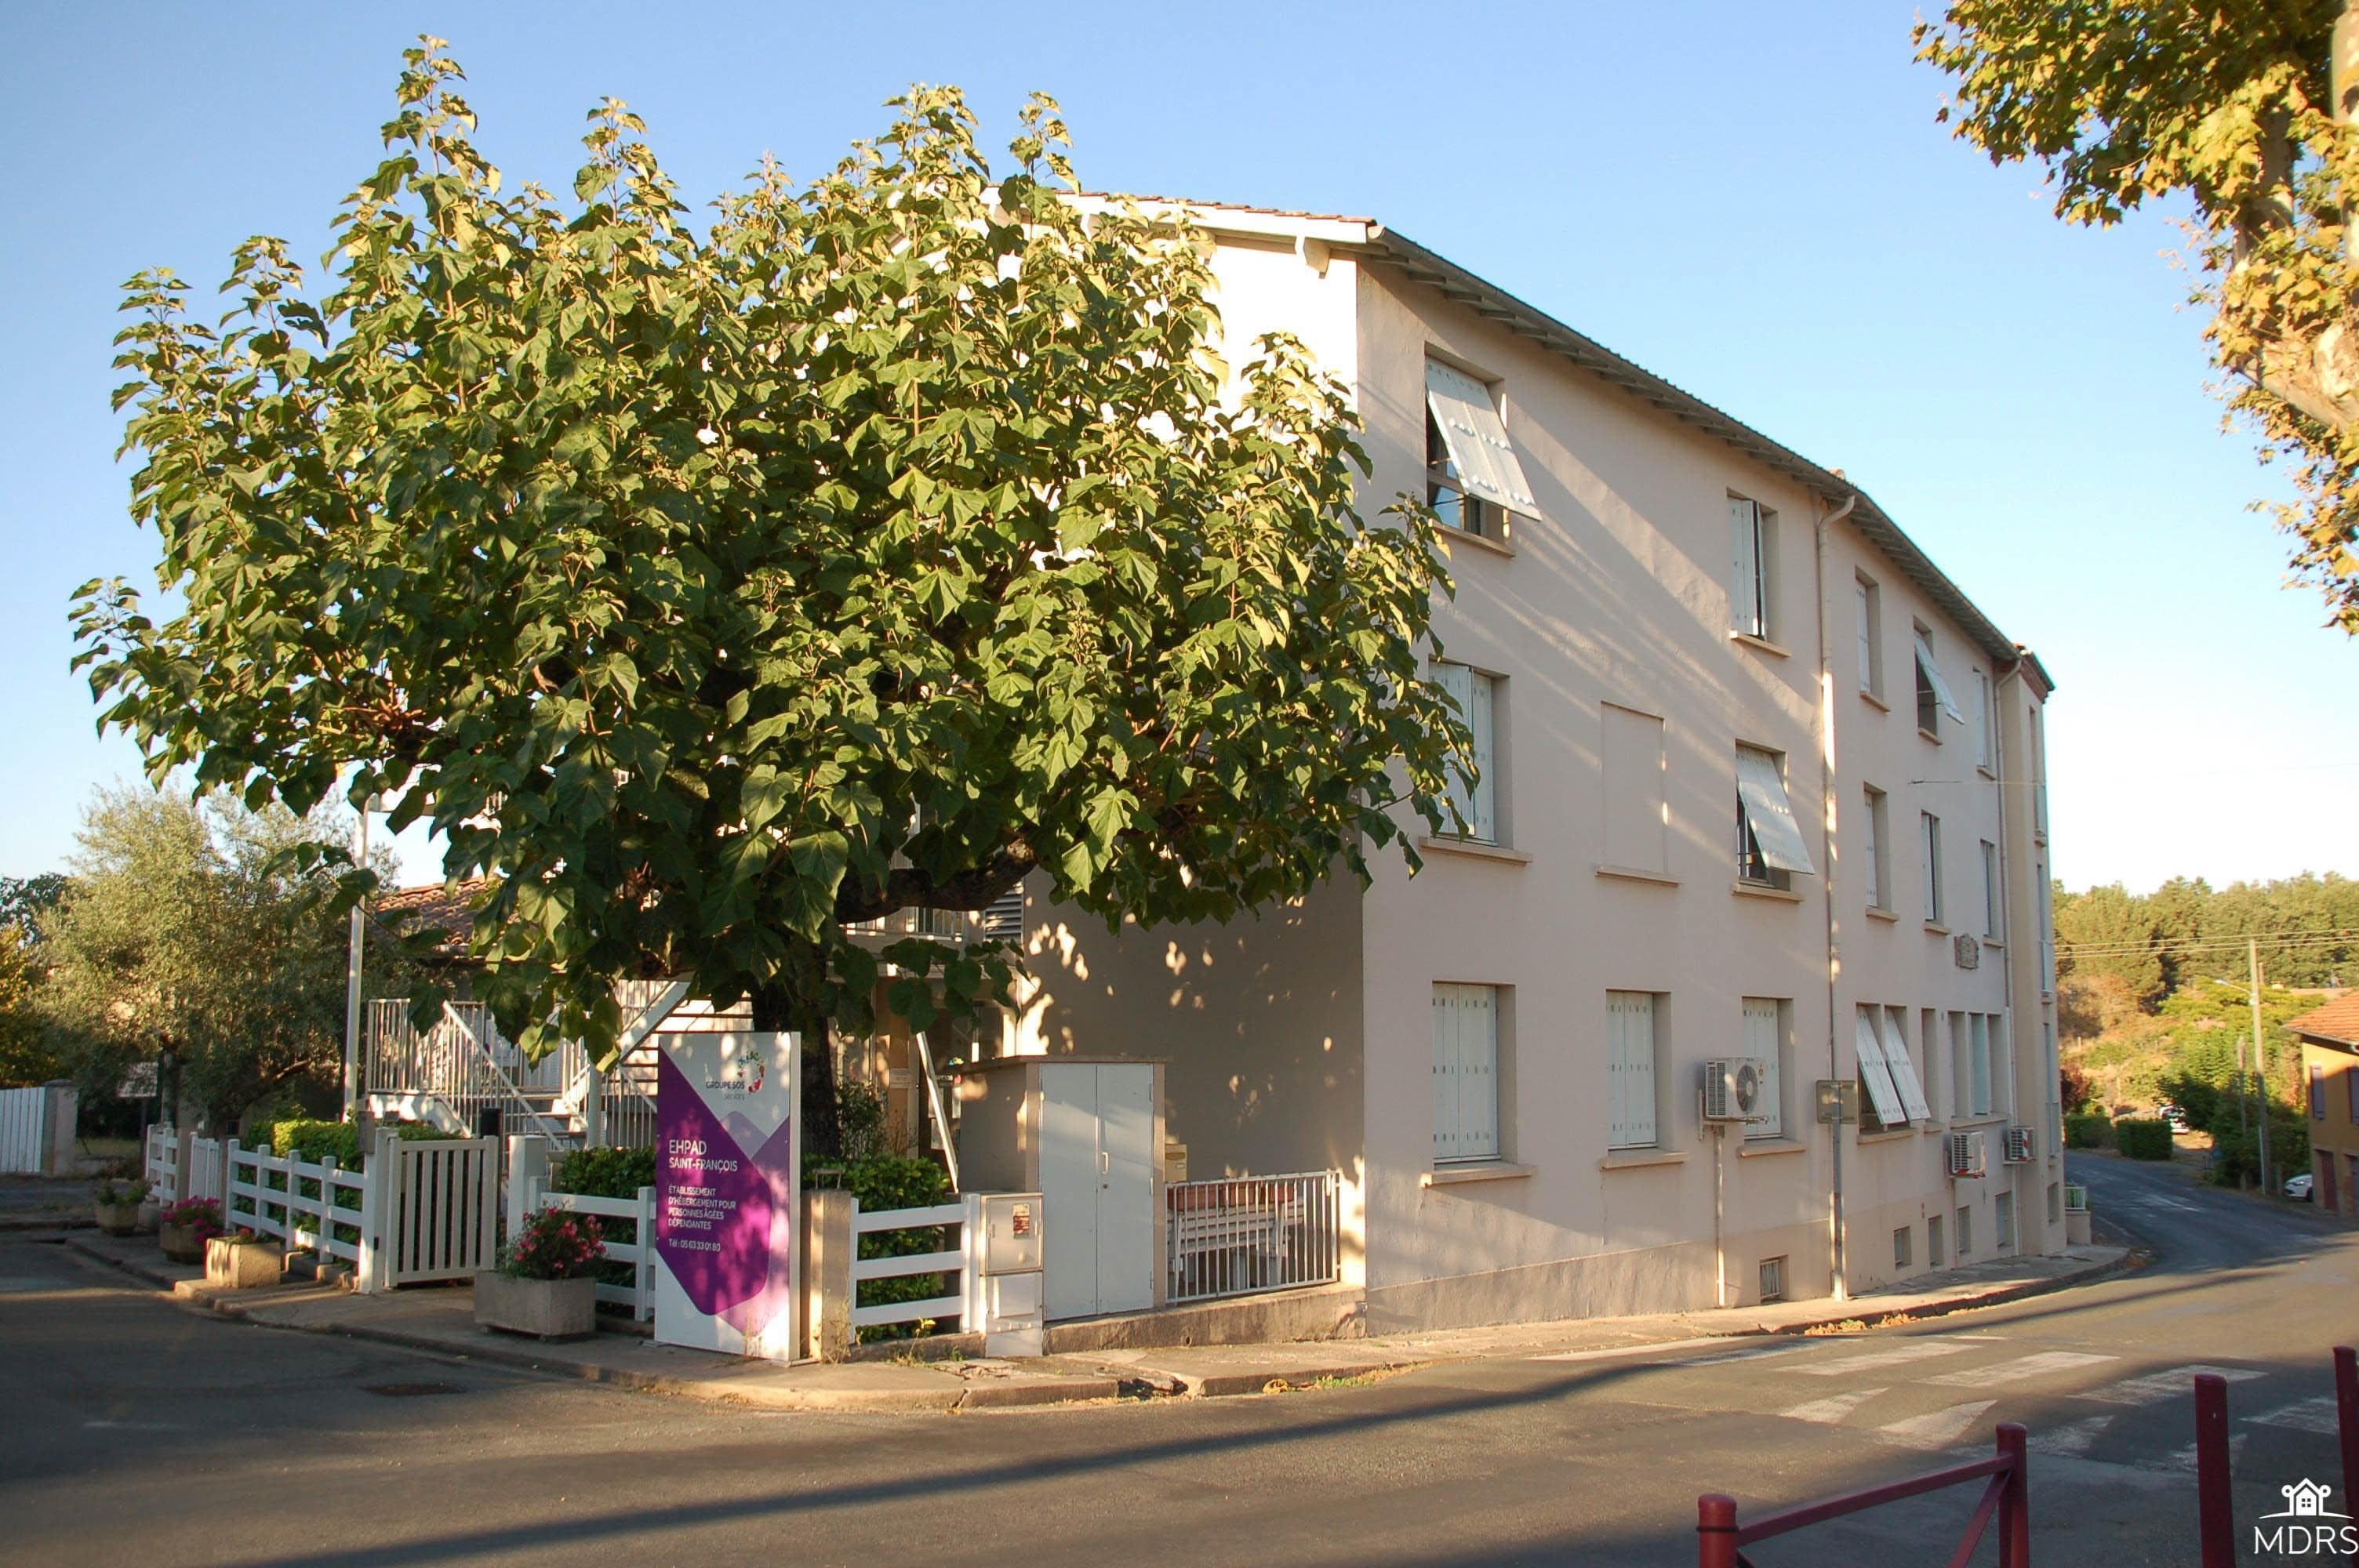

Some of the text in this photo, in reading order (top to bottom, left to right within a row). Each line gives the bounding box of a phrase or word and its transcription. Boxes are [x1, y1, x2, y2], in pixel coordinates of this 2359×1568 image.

[669, 1139, 707, 1155] EHPAD
[669, 1156, 738, 1173] SAINT-FRANÇOIS
[668, 1185, 715, 1196] ÉTABLISSEMENT
[718, 1200, 736, 1209] POUR
[668, 1207, 703, 1218] PERSONNES
[668, 1217, 711, 1229] DÉPENDANTES
[681, 1240, 688, 1248] 05
[705, 1242, 711, 1250] 01
